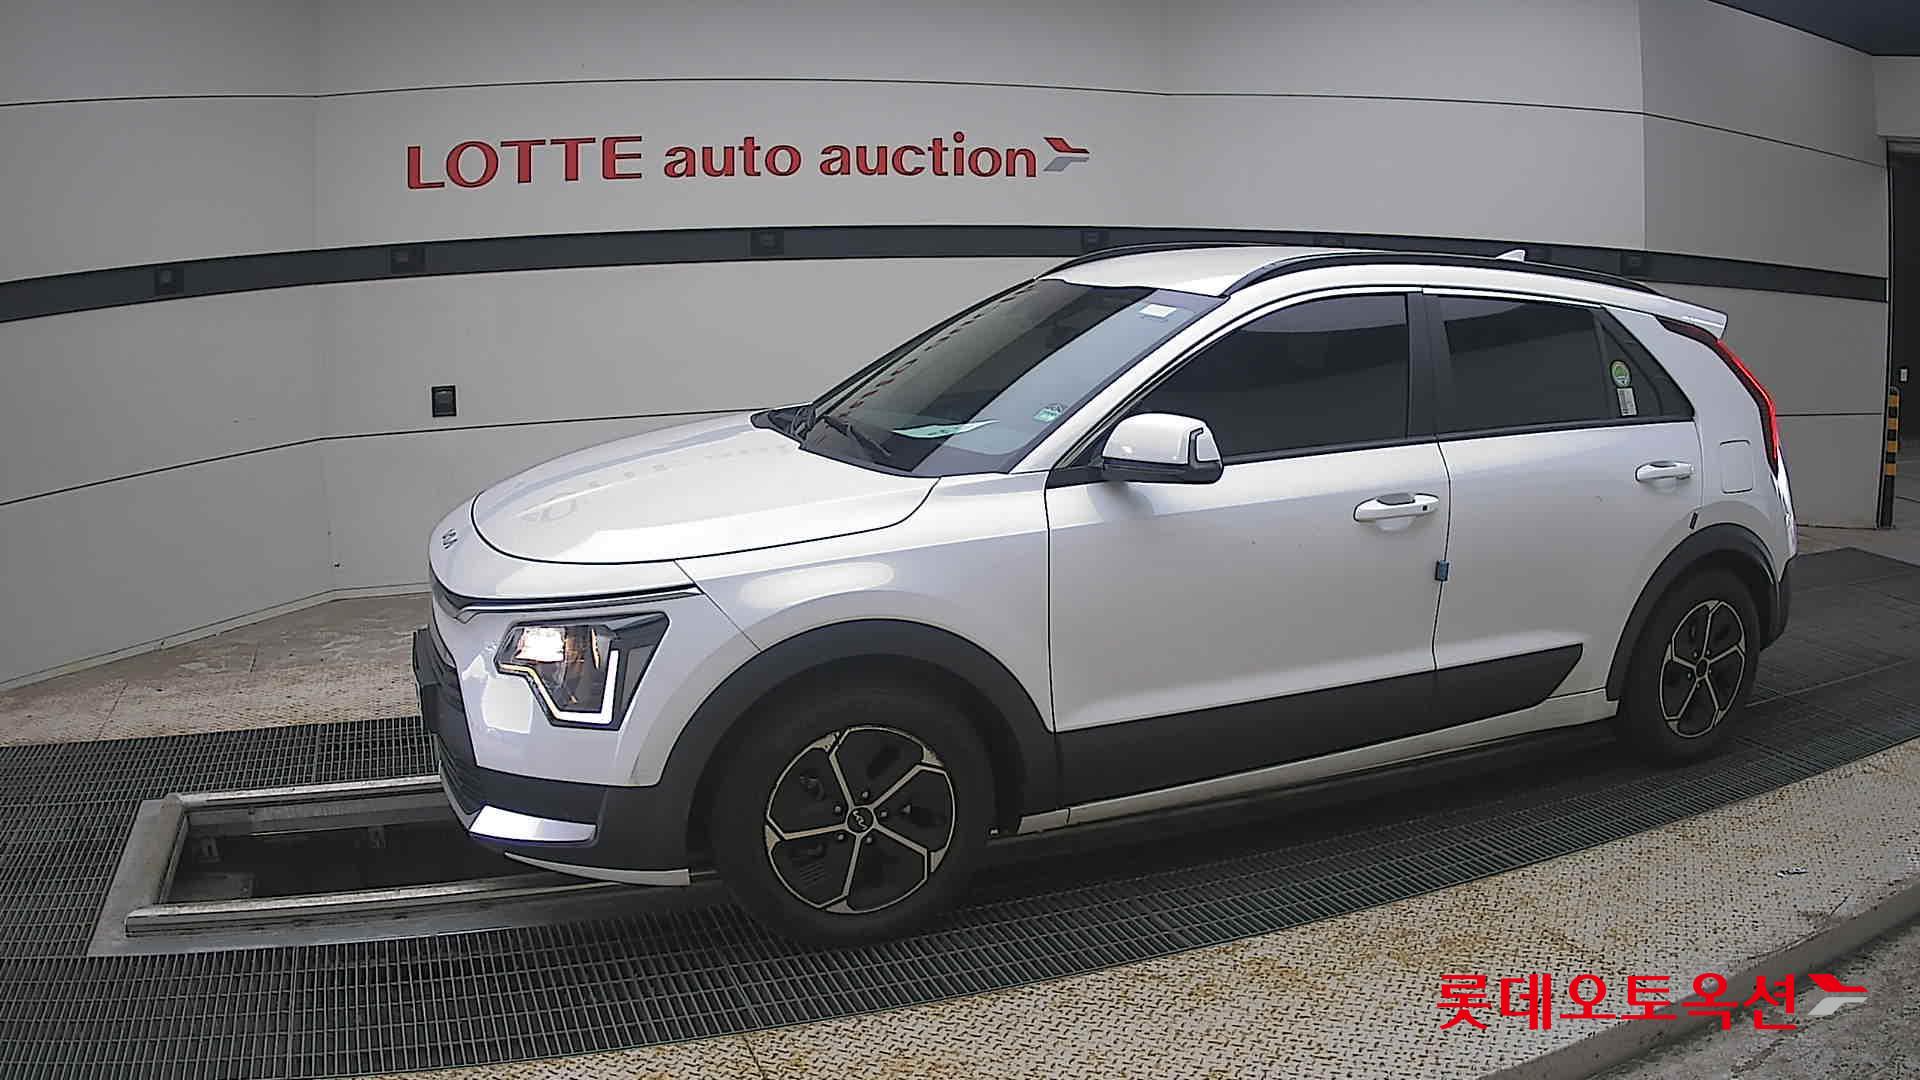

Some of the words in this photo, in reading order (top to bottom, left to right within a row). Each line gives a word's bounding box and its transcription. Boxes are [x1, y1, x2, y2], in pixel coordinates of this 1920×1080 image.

[407, 136, 642, 189] LOTTE
[663, 136, 801, 178] auto
[819, 131, 1037, 177] auction
